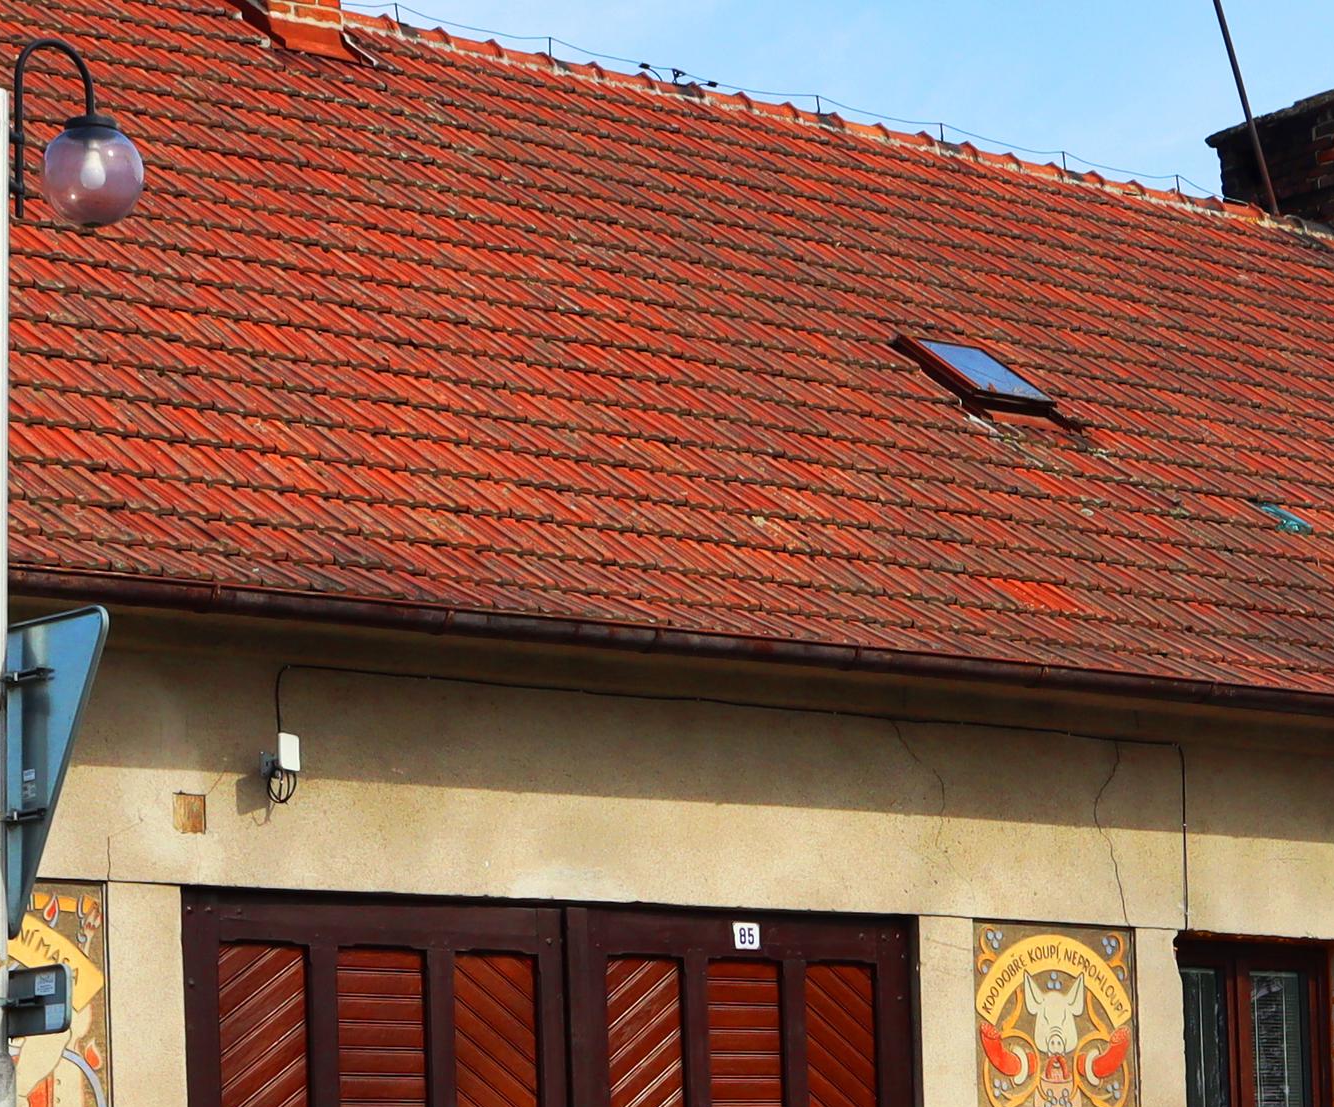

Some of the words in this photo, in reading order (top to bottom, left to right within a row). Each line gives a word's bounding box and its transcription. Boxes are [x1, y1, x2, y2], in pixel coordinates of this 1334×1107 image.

[739, 927, 755, 945] 85
[982, 986, 999, 1014] KDO
[998, 954, 1027, 989] DOBŘE
[1027, 942, 1062, 964] KOUPÍ,
[1064, 948, 1129, 1017] NEPROHLOUPÍ
